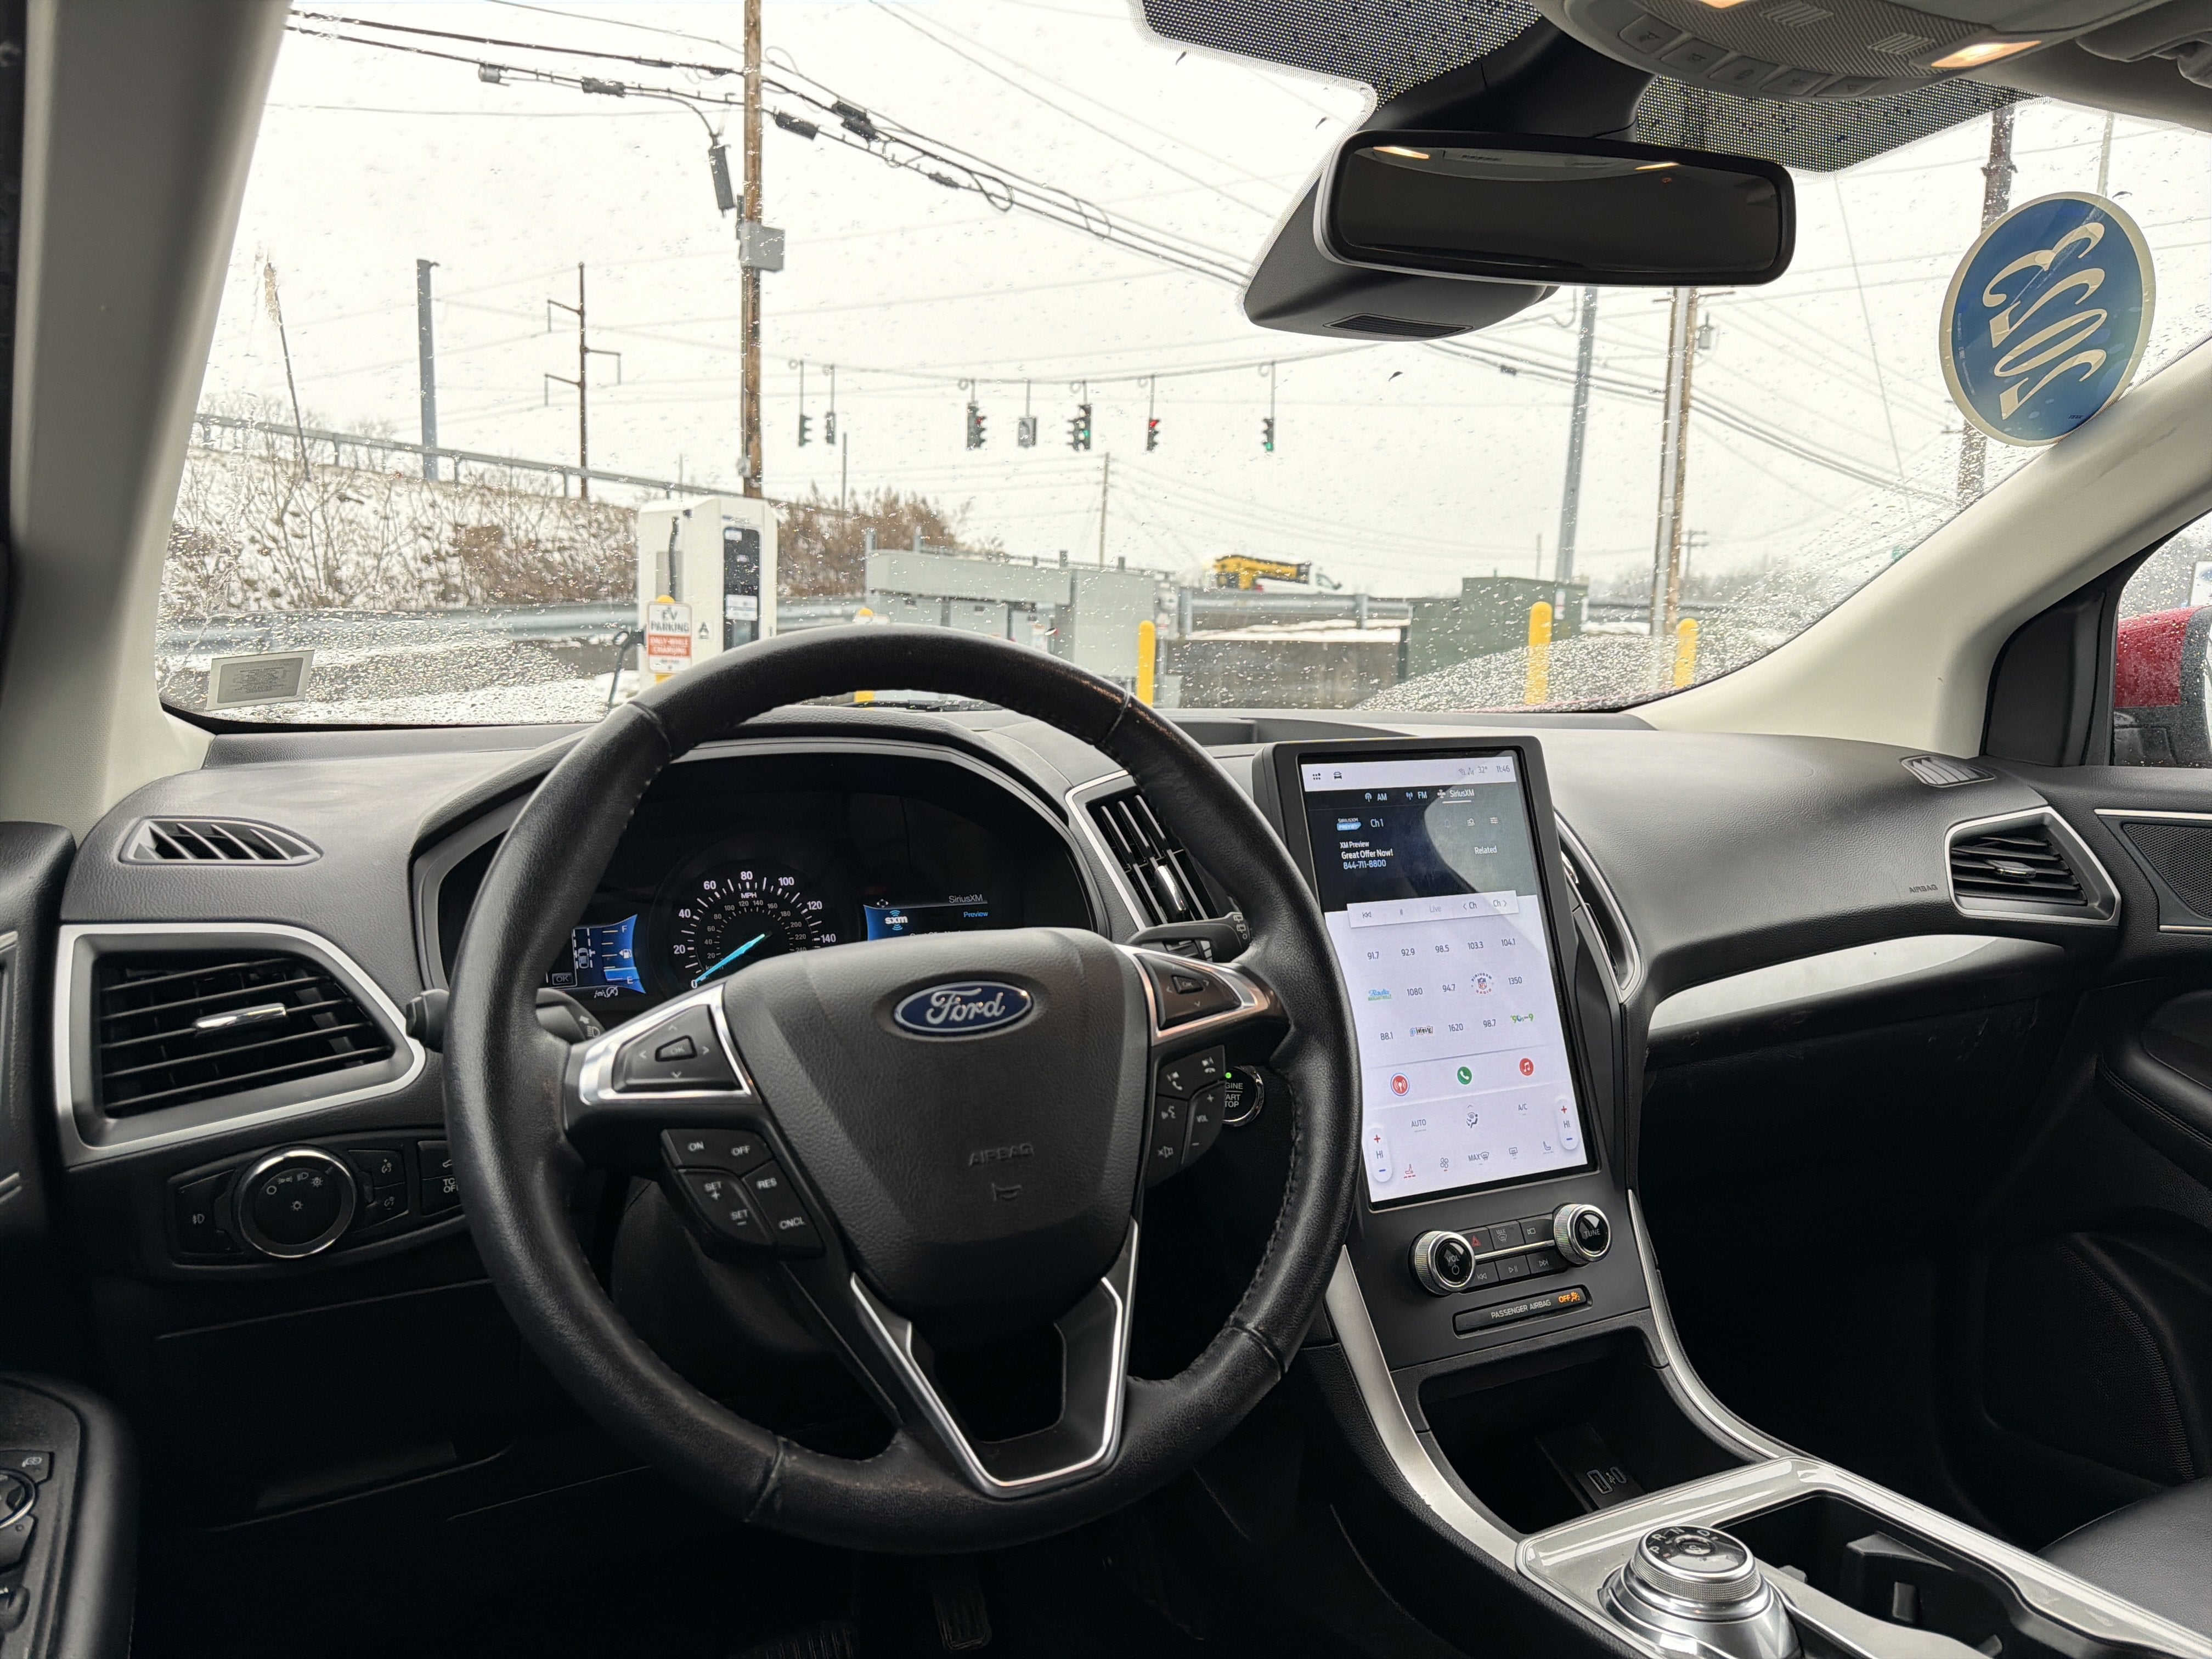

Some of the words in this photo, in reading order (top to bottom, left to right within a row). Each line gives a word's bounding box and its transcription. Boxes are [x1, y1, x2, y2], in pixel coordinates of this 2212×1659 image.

[651, 620, 689, 633] PARKING
[1376, 792, 1387, 801] AM
[1417, 791, 1427, 799] FM
[1449, 789, 1475, 798] SiriusXM
[1370, 819, 1380, 827] Ch
[1380, 818, 1384, 827] 1
[1339, 841, 1349, 849] XM
[1349, 840, 1370, 849] Preview
[1341, 850, 1360, 860] Great
[1360, 849, 1376, 858] Offer
[1376, 848, 1394, 857] Now!
[1474, 845, 1497, 855] Related
[1342, 859, 1386, 870] 844-711-8800
[741, 871, 753, 880] 80
[703, 881, 716, 890] 60
[778, 877, 794, 887] 100
[1909, 884, 1938, 893] AIRBAG
[949, 894, 983, 904] SiriusXM
[806, 901, 822, 910] 120
[1429, 904, 1442, 913] Live
[1469, 901, 1477, 910] Ch
[1492, 899, 1502, 908] Ch
[678, 909, 691, 918] 40
[884, 916, 909, 924] sxm
[820, 933, 836, 943] 140
[673, 944, 686, 954] 20
[1367, 951, 1379, 960] 91.7
[1401, 948, 1416, 957] 92.9
[1435, 944, 1449, 953] 98.5
[1468, 941, 1484, 950] 103.3
[1501, 938, 1516, 947] 104.1
[691, 979, 697, 989] 0
[1407, 987, 1423, 996] 1080
[1442, 983, 1456, 992] 94.7
[1508, 977, 1522, 985] 1350
[925, 987, 1006, 1025] Ford
[1380, 1031, 1393, 1041] 88.1
[1415, 1026, 1432, 1035] WAVE
[1448, 1023, 1464, 1032] 1620
[1483, 1019, 1497, 1029] 98.7
[670, 1046, 685, 1055] OK
[1518, 1103, 1528, 1111] A/C
[1411, 1119, 1426, 1128] AUTO
[1563, 1120, 1570, 1129] HI
[687, 1141, 704, 1152] ON
[731, 1145, 751, 1156] OFF
[1376, 1150, 1384, 1159] HI
[1468, 1154, 1481, 1163] MAX
[704, 1181, 723, 1192] SET
[756, 1178, 777, 1189] RES
[730, 1209, 748, 1221] SET
[778, 1216, 806, 1230] CNCL
[1583, 1228, 1601, 1237] TUNE
[1491, 1304, 1528, 1319] PASSENGER
[1530, 1299, 1551, 1311] AIRBAG
[1558, 1294, 1571, 1303] OFF
[1649, 1545, 1660, 1554] P
